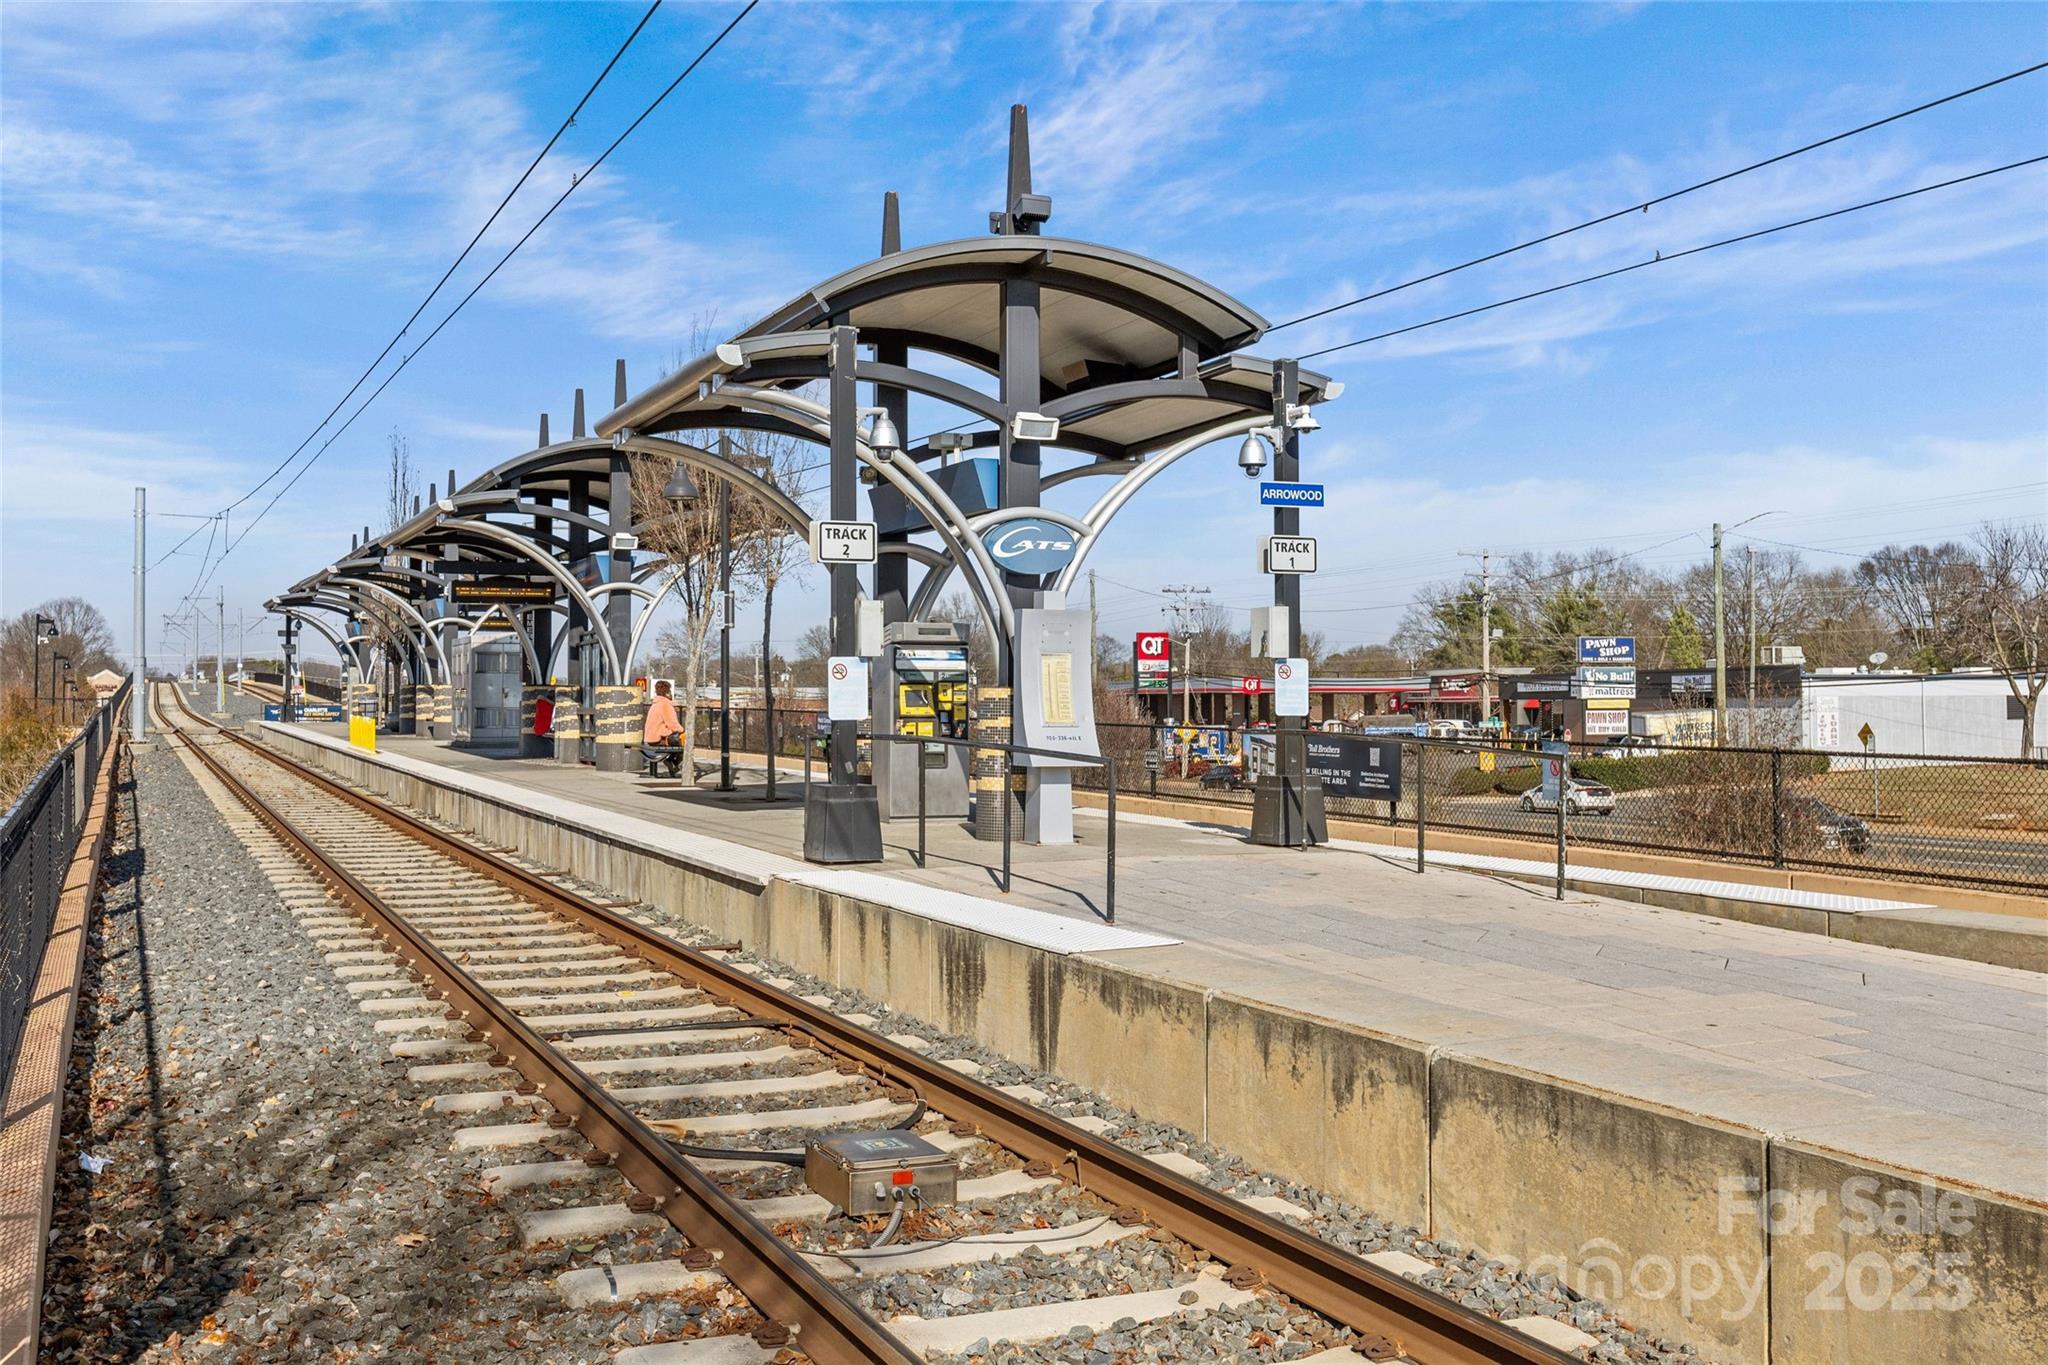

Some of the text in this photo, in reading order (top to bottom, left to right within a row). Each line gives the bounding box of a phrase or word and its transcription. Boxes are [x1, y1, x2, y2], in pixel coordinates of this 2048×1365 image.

[1262, 488, 1322, 501] ARROWOOD
[825, 527, 867, 540] TRACK
[992, 526, 1072, 558] CATS
[1274, 541, 1310, 554] TRACK
[842, 543, 850, 556] 2
[1289, 556, 1295, 569] 1
[1141, 636, 1164, 656] QT
[1585, 638, 1617, 649] PAWN
[1599, 645, 1630, 657] SHOP
[1595, 670, 1634, 681] No Bull!
[1245, 678, 1259, 691] QT
[1594, 687, 1634, 696] mattress
[1587, 712, 1627, 723] PAWN SHOP
[1311, 767, 1332, 776] SELLING
[1333, 769, 1340, 777] IN
[1341, 769, 1351, 778] THE
[1331, 777, 1347, 785] AREA
